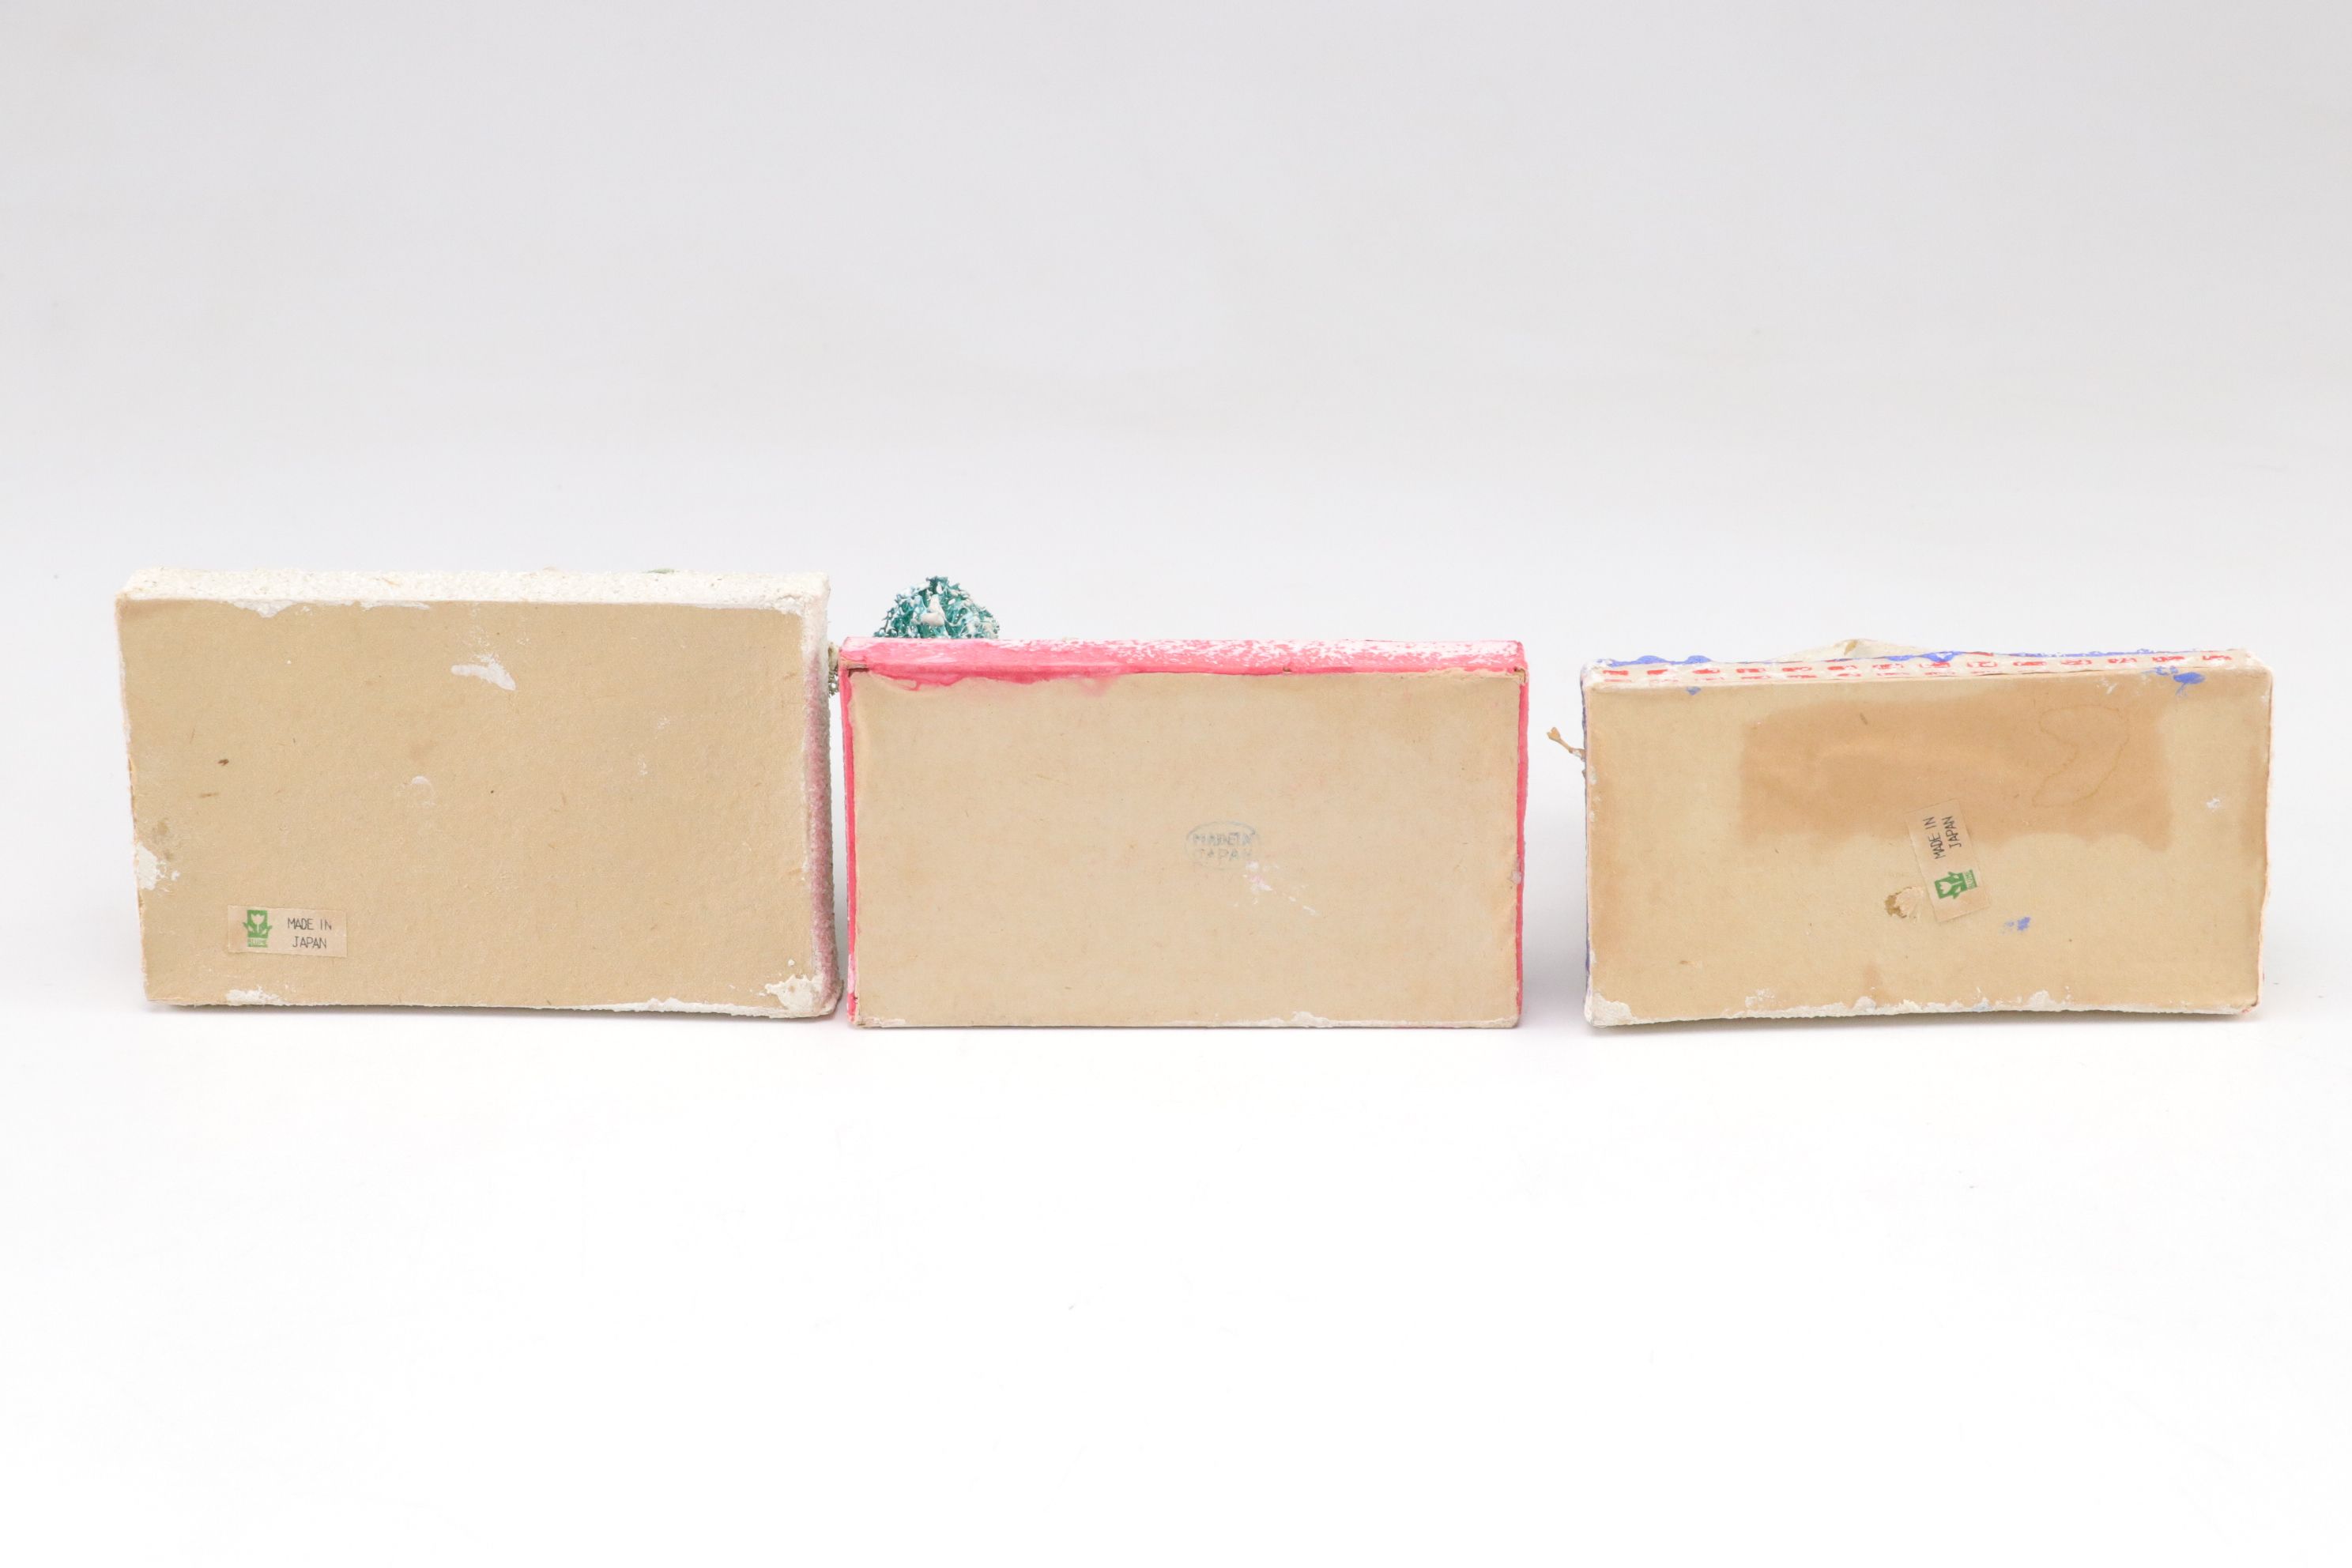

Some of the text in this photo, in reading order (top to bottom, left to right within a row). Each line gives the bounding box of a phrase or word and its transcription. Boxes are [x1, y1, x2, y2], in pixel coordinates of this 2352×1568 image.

[1922, 816, 1946, 859] MADE IN
[1941, 816, 1962, 849] JAPAN
[287, 918, 332, 930] MADE IN
[292, 936, 327, 949] JAPAN
